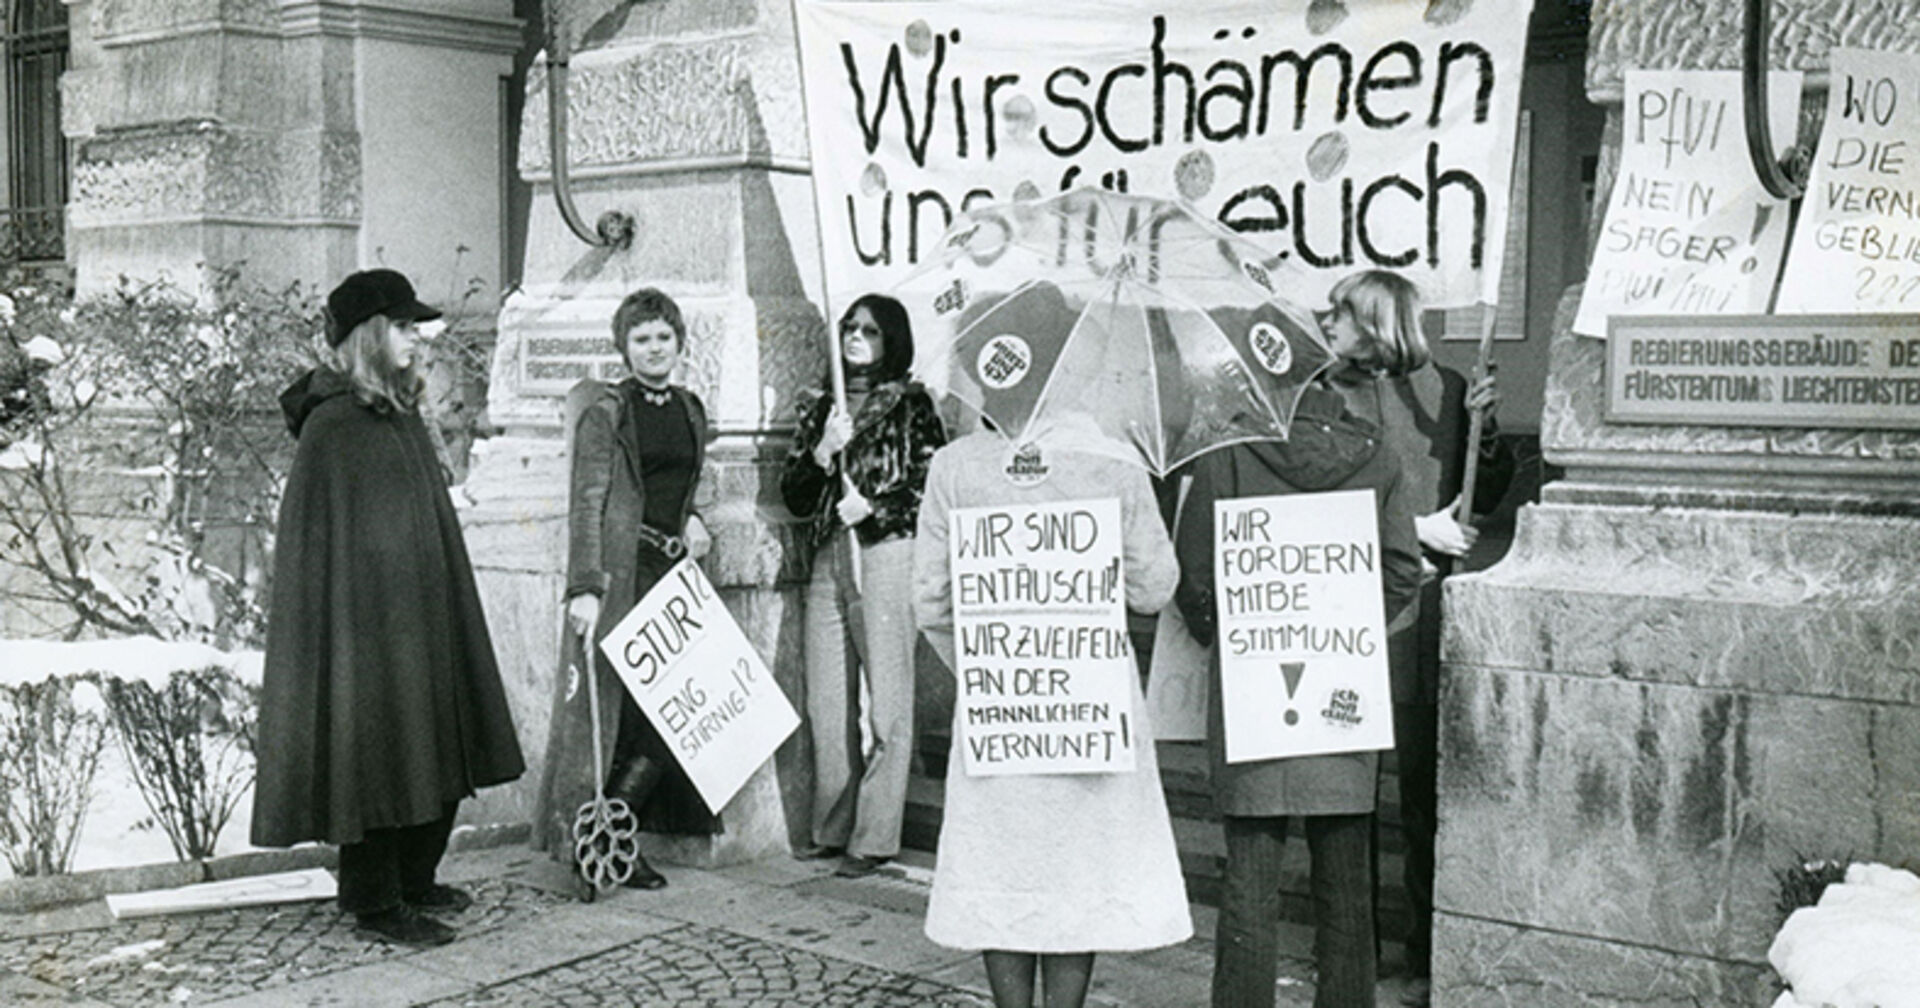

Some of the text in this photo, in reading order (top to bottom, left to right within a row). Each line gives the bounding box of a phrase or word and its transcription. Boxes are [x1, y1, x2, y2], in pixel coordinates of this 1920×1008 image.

[840, 15, 1494, 167] Wir schämen
[1842, 75, 1898, 127] WO
[1827, 137, 1907, 175] DIE
[1217, 142, 1488, 269] euch
[1621, 171, 1714, 220] NEIN
[1828, 177, 1920, 219] VERN
[1630, 335, 1870, 367] REGIERUNGSGEBÄUDE
[956, 510, 1099, 559] WIR SIND
[1222, 508, 1272, 542] WIR
[1222, 543, 1374, 577] FORDERN
[1226, 581, 1310, 615] MITBE
[962, 622, 1129, 660] WIR ZWEIFELN
[1228, 624, 1376, 657] STIMMUNG
[964, 666, 1071, 697] AN DER
[658, 676, 706, 735] ENG
